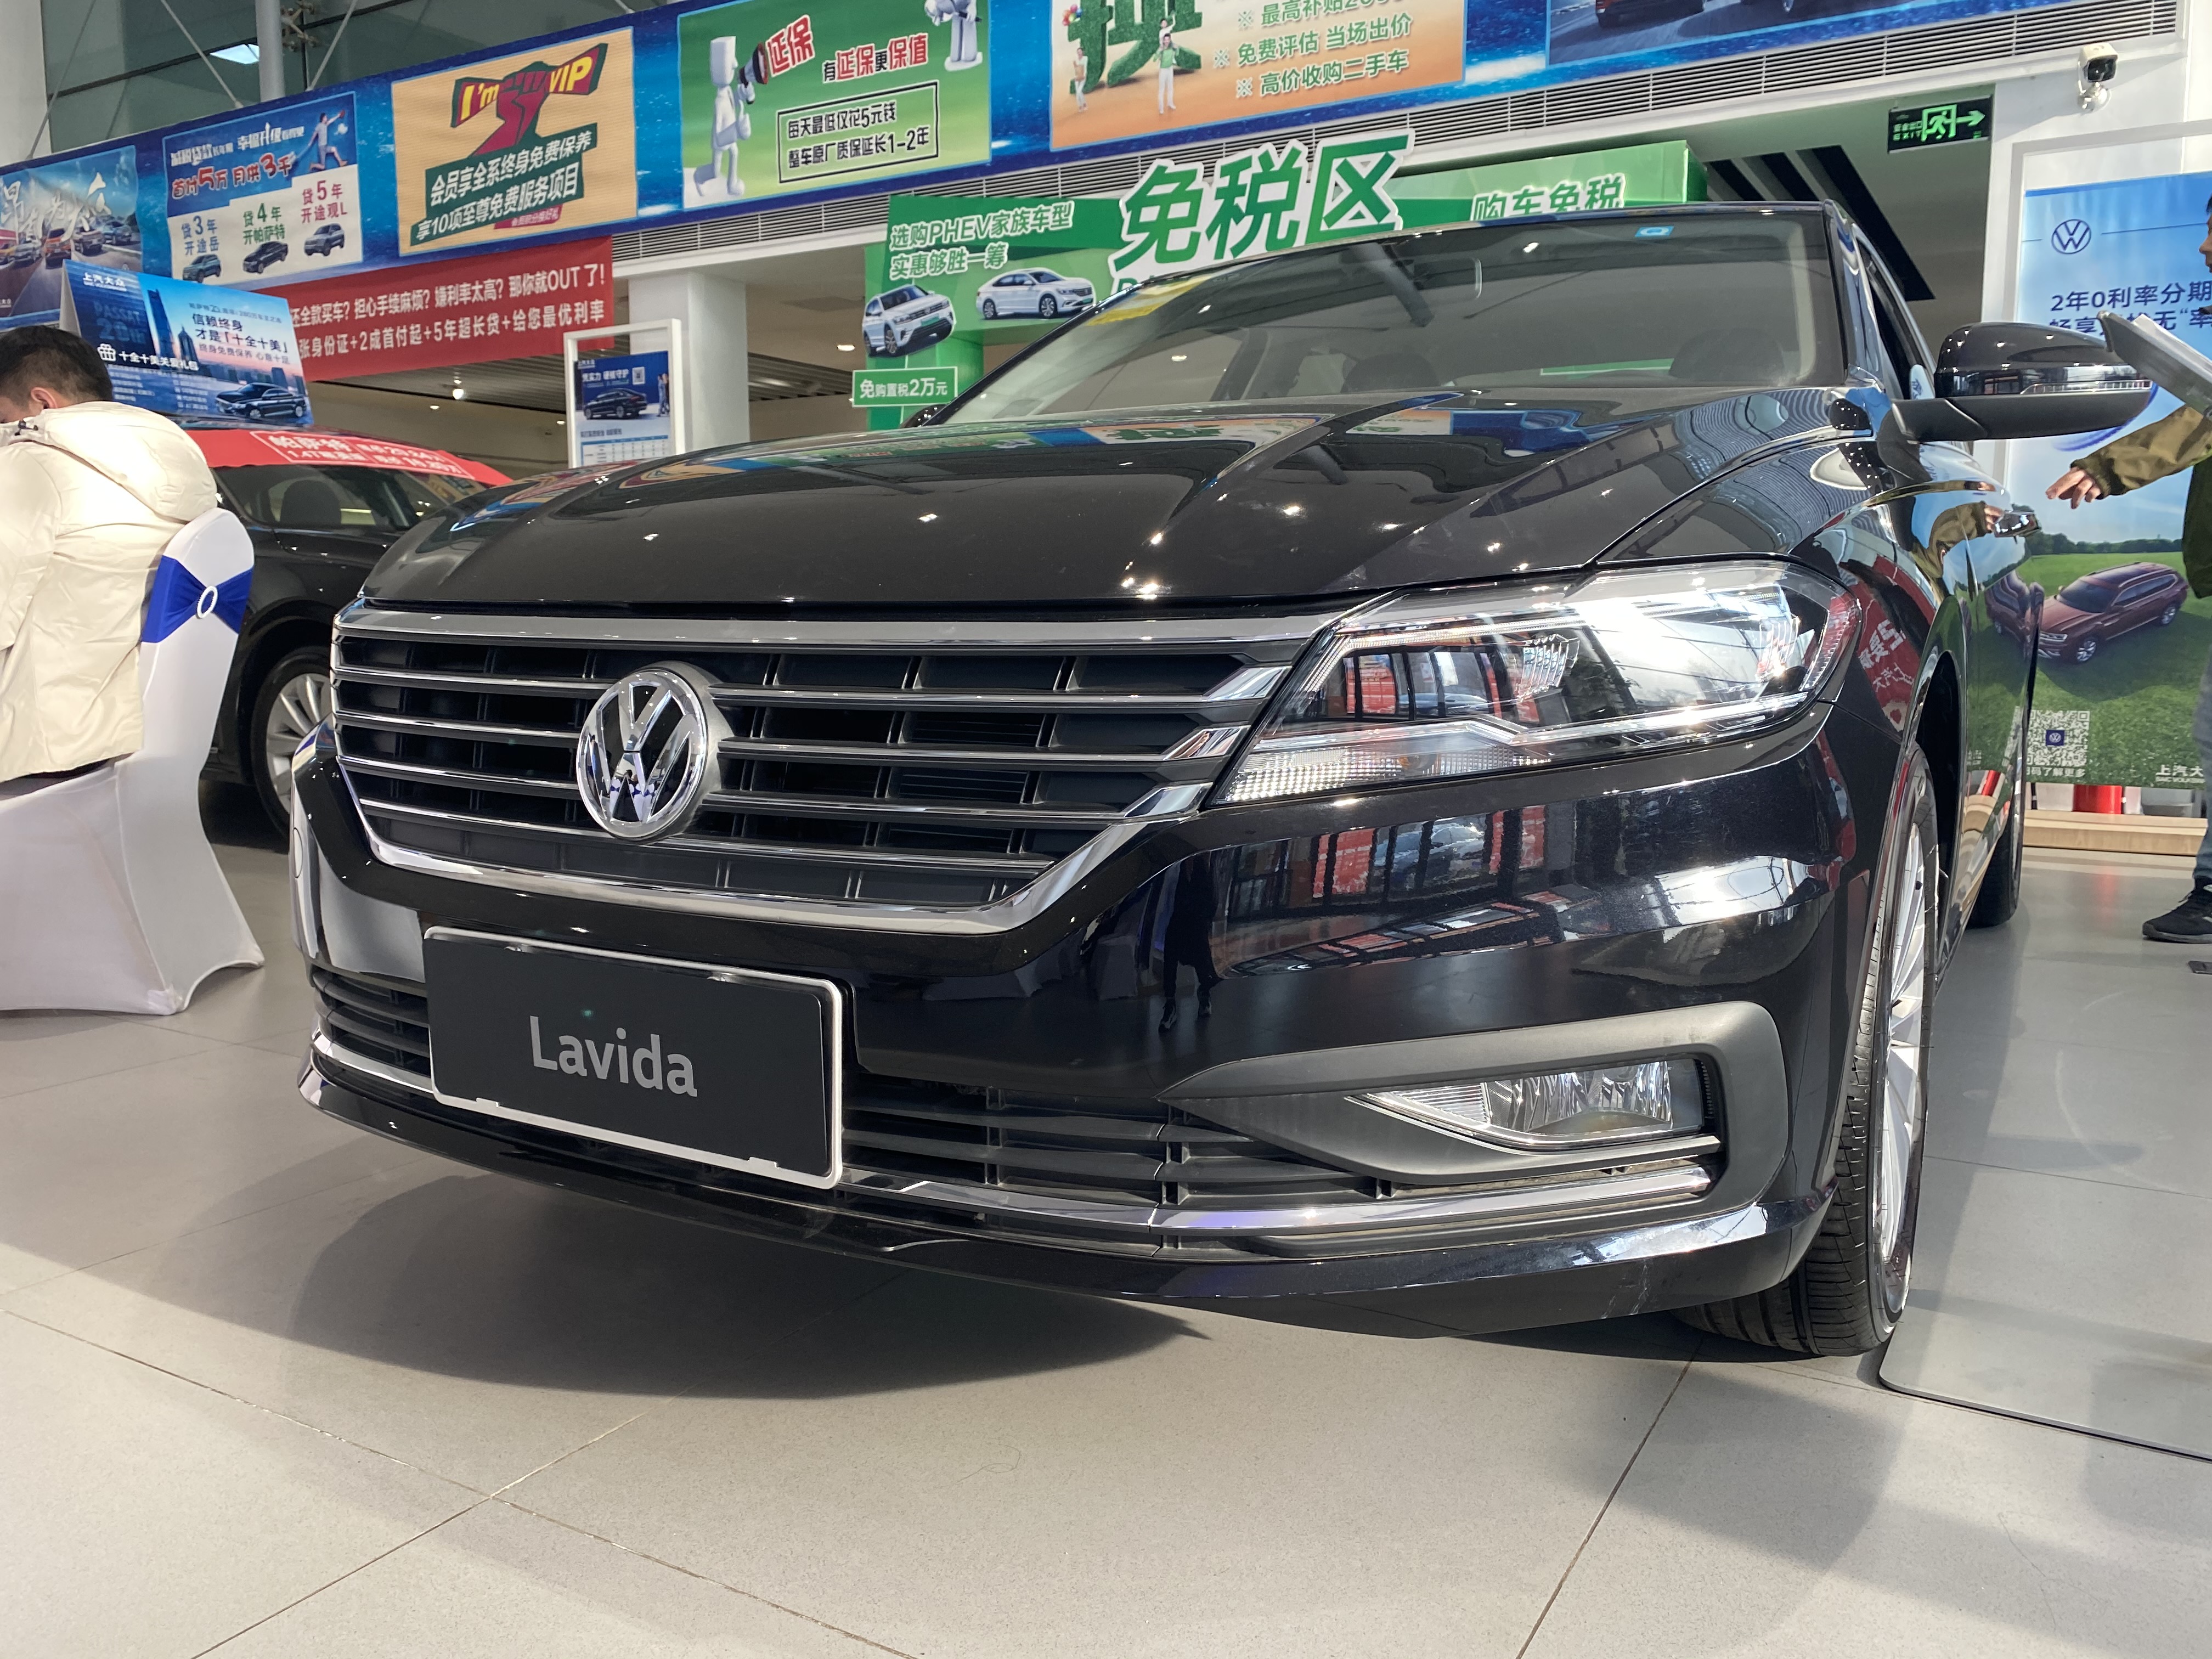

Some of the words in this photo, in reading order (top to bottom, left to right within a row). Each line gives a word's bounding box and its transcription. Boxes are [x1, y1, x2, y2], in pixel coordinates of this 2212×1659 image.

[769, 16, 814, 76] 延保
[823, 33, 928, 83] 有延保更保值
[1238, 32, 1319, 67] 免费评估
[1325, 14, 1413, 49] 当场出价
[460, 83, 499, 121] I'm
[549, 56, 594, 93] VIP
[1260, 49, 1409, 95] 高价收购二手车
[788, 101, 897, 139] 每天最低仅花5元钱
[302, 180, 343, 205] 贷5年
[430, 130, 592, 207] 会员享全系终身免费保养
[243, 202, 282, 228] 贷4年
[415, 162, 579, 241] 享10项至尊免费服务项目
[1114, 134, 1409, 272] 免税区
[1472, 174, 1626, 221] 购车免税
[181, 215, 218, 239] 贷3年
[890, 201, 1075, 251] 选购PHEV家族车型
[890, 242, 1008, 280] 实惠够胜一筹
[2050, 280, 2212, 312] 2年0利率分期
[860, 377, 948, 399] 免购置税2万元
[529, 1015, 697, 1097] Lavida
